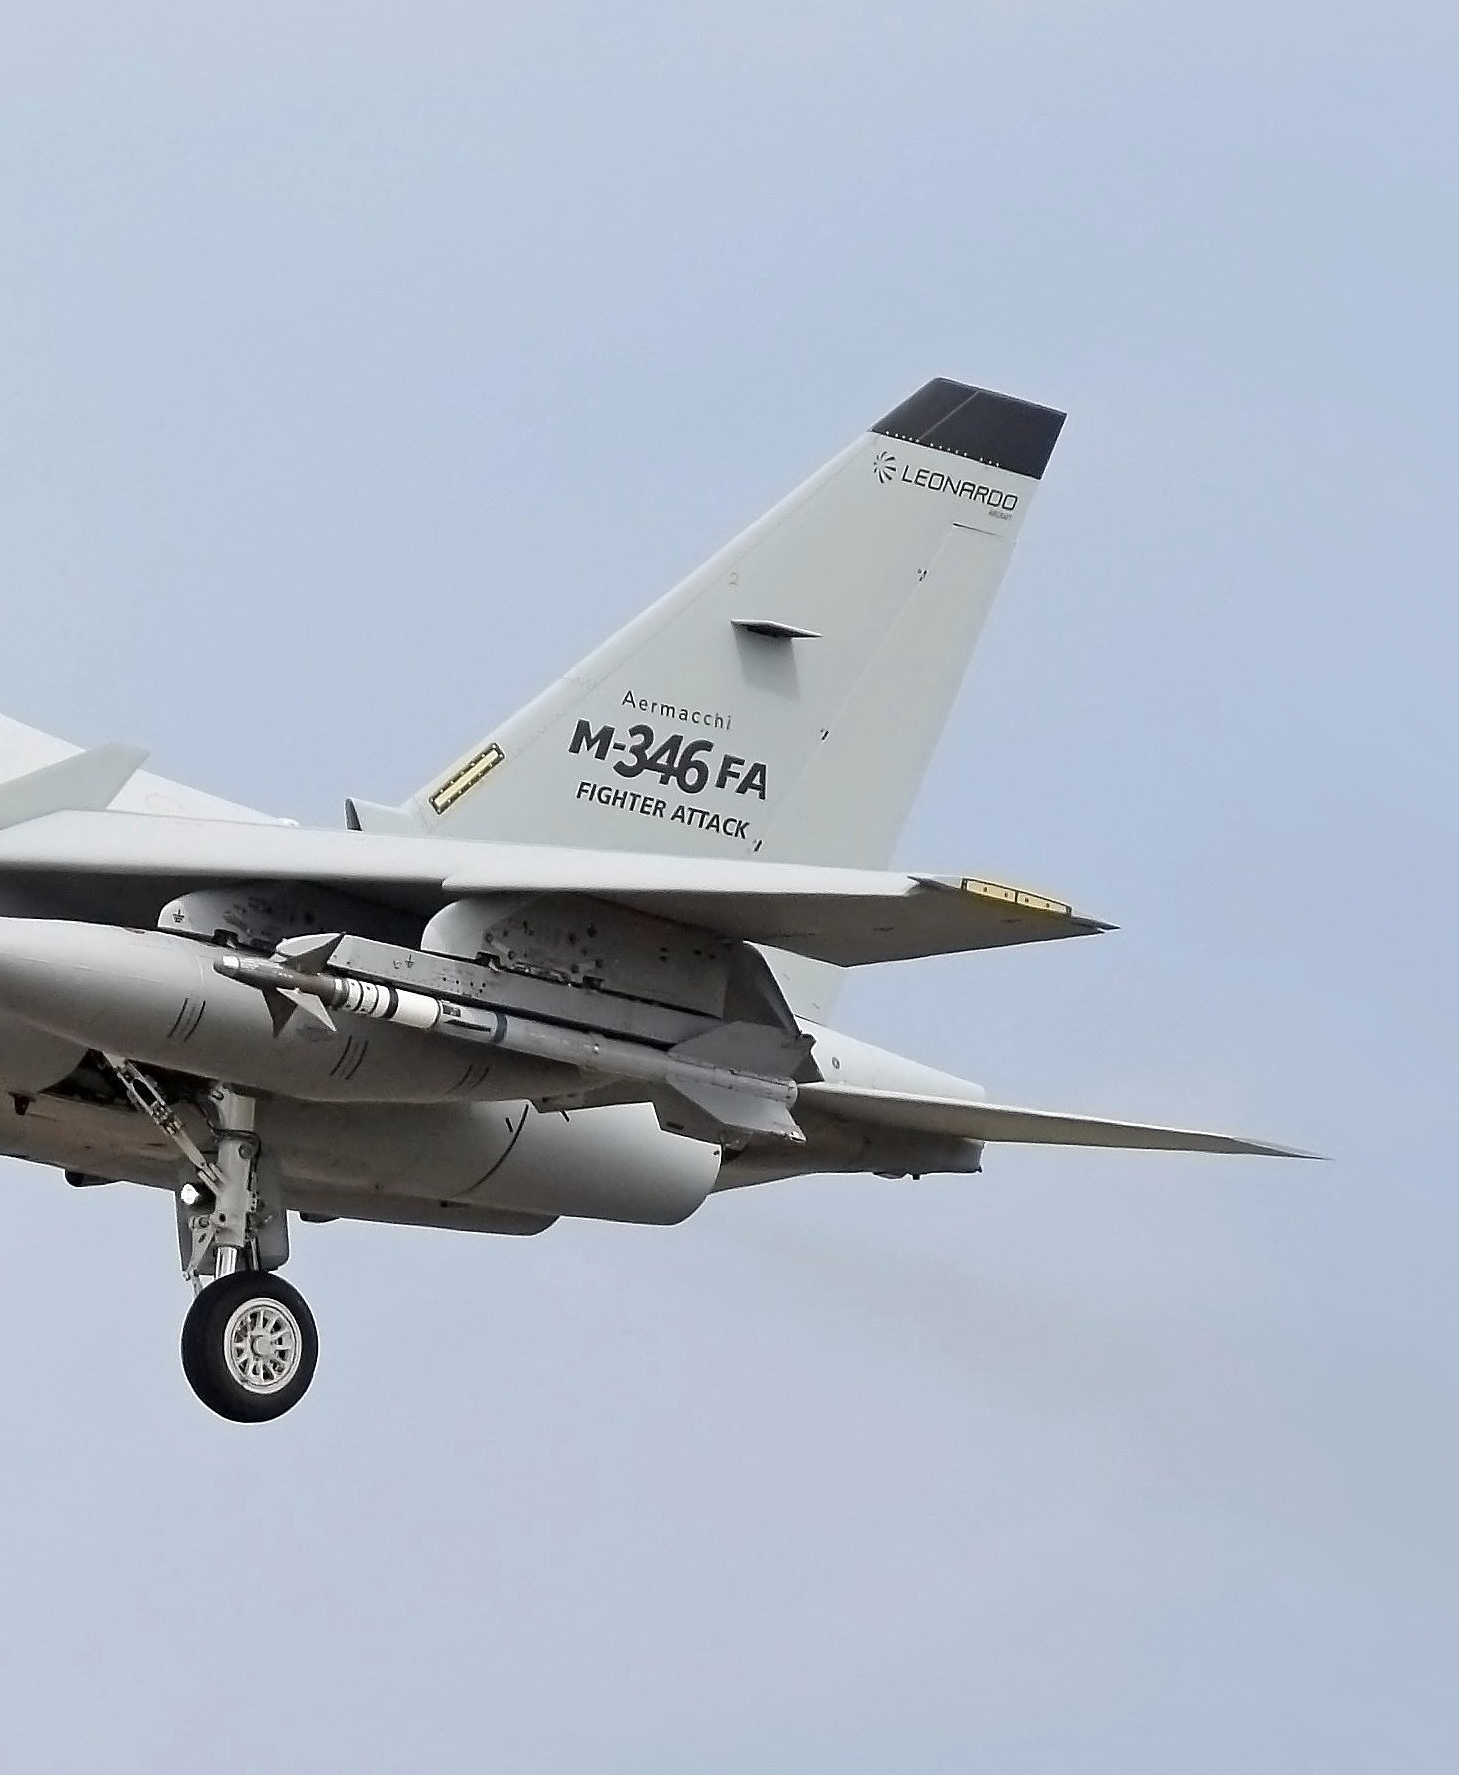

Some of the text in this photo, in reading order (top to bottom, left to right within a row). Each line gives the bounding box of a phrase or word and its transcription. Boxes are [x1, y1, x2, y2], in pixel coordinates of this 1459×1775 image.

[902, 465, 1018, 510] LEONARDO
[622, 690, 732, 730] Aermacchi
[568, 719, 767, 800] M-346 FA
[576, 781, 750, 840] FIGHTER ATTACK
